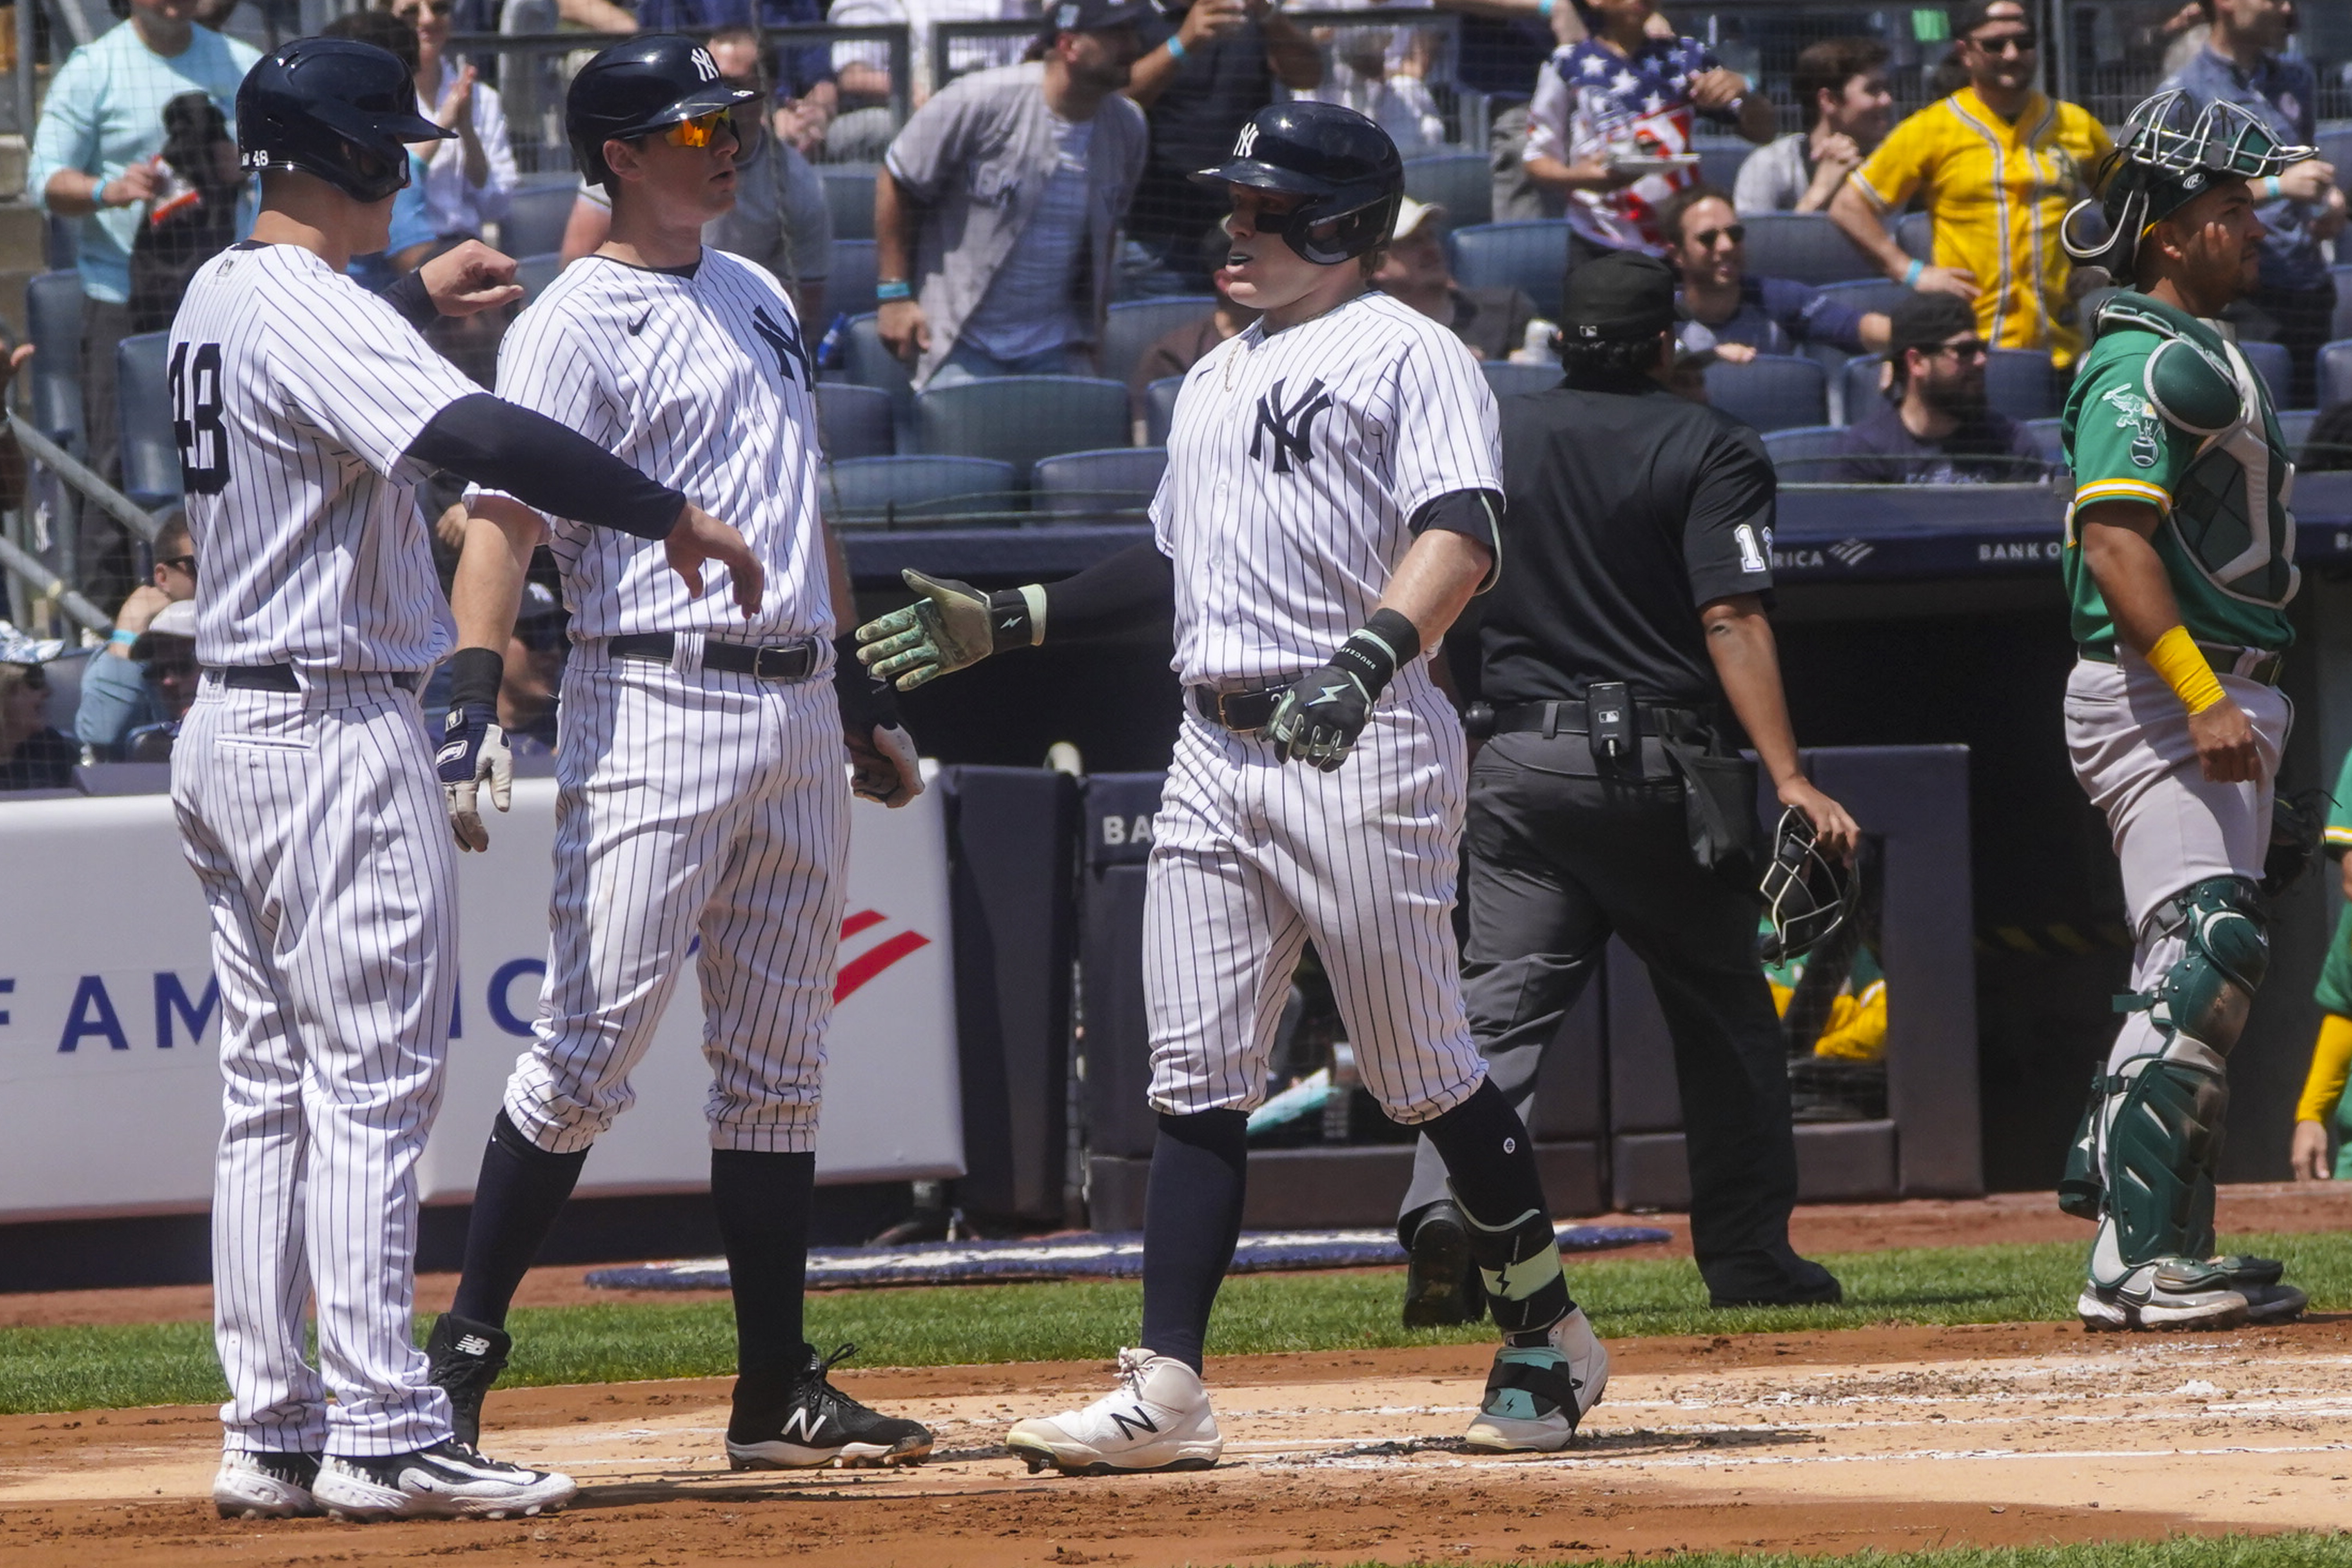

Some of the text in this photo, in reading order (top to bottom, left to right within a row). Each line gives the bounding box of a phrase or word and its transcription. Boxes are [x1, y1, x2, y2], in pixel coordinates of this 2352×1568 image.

[253, 150, 268, 166] 48
[1249, 376, 1333, 474] NY
[1734, 524, 1773, 573] 1
[1980, 543, 2039, 561] BANK
